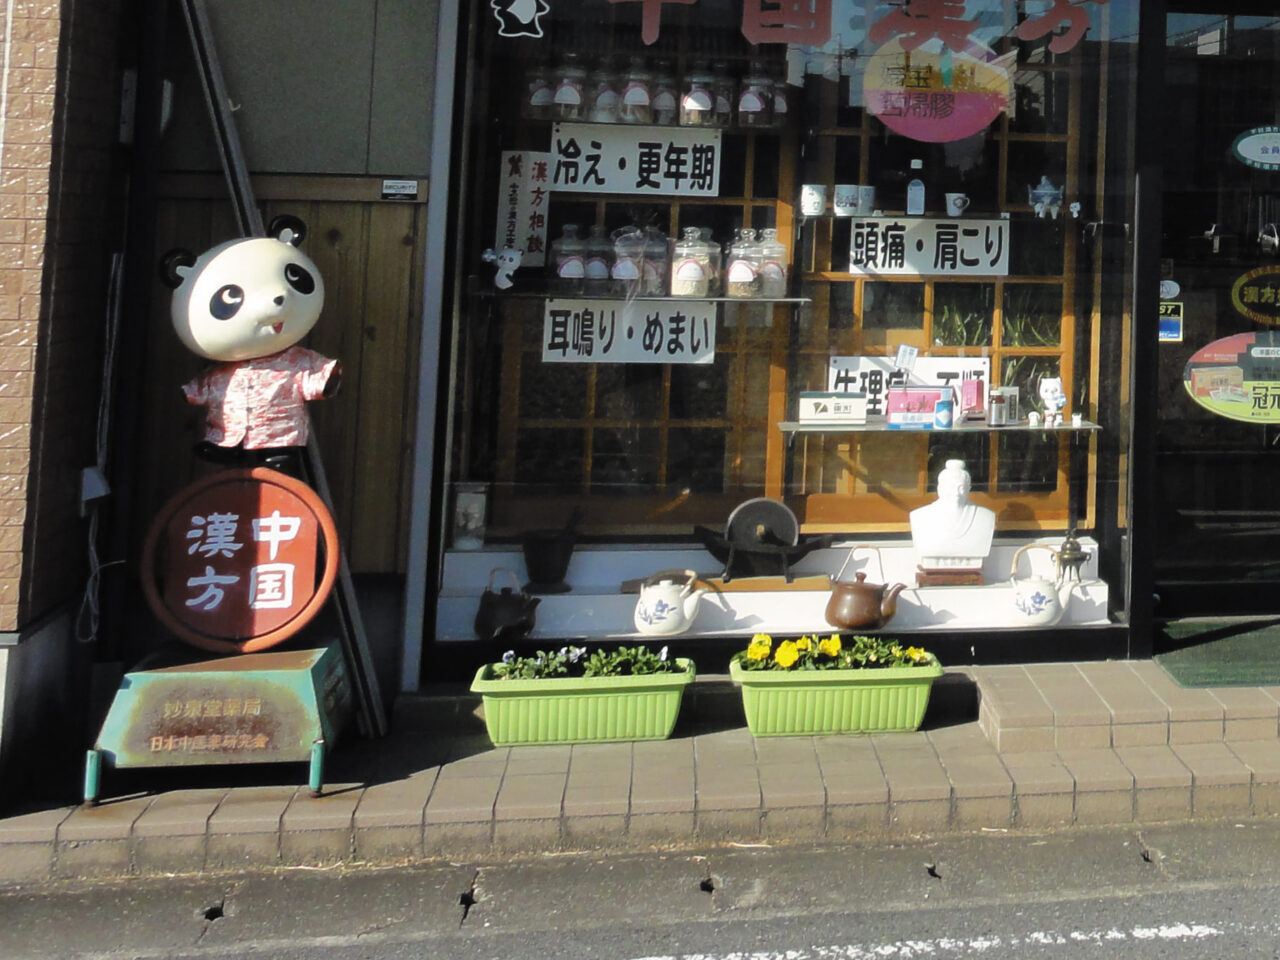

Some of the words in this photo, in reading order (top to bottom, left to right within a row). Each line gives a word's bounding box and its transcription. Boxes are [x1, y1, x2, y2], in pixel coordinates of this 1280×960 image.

[553, 138, 715, 190] 冷え・更年期
[852, 220, 1004, 270] 頭痛・肩こり
[548, 308, 713, 358] 耳鳴り・めまい
[185, 512, 243, 610] 漢方
[249, 510, 300, 609] 中国
